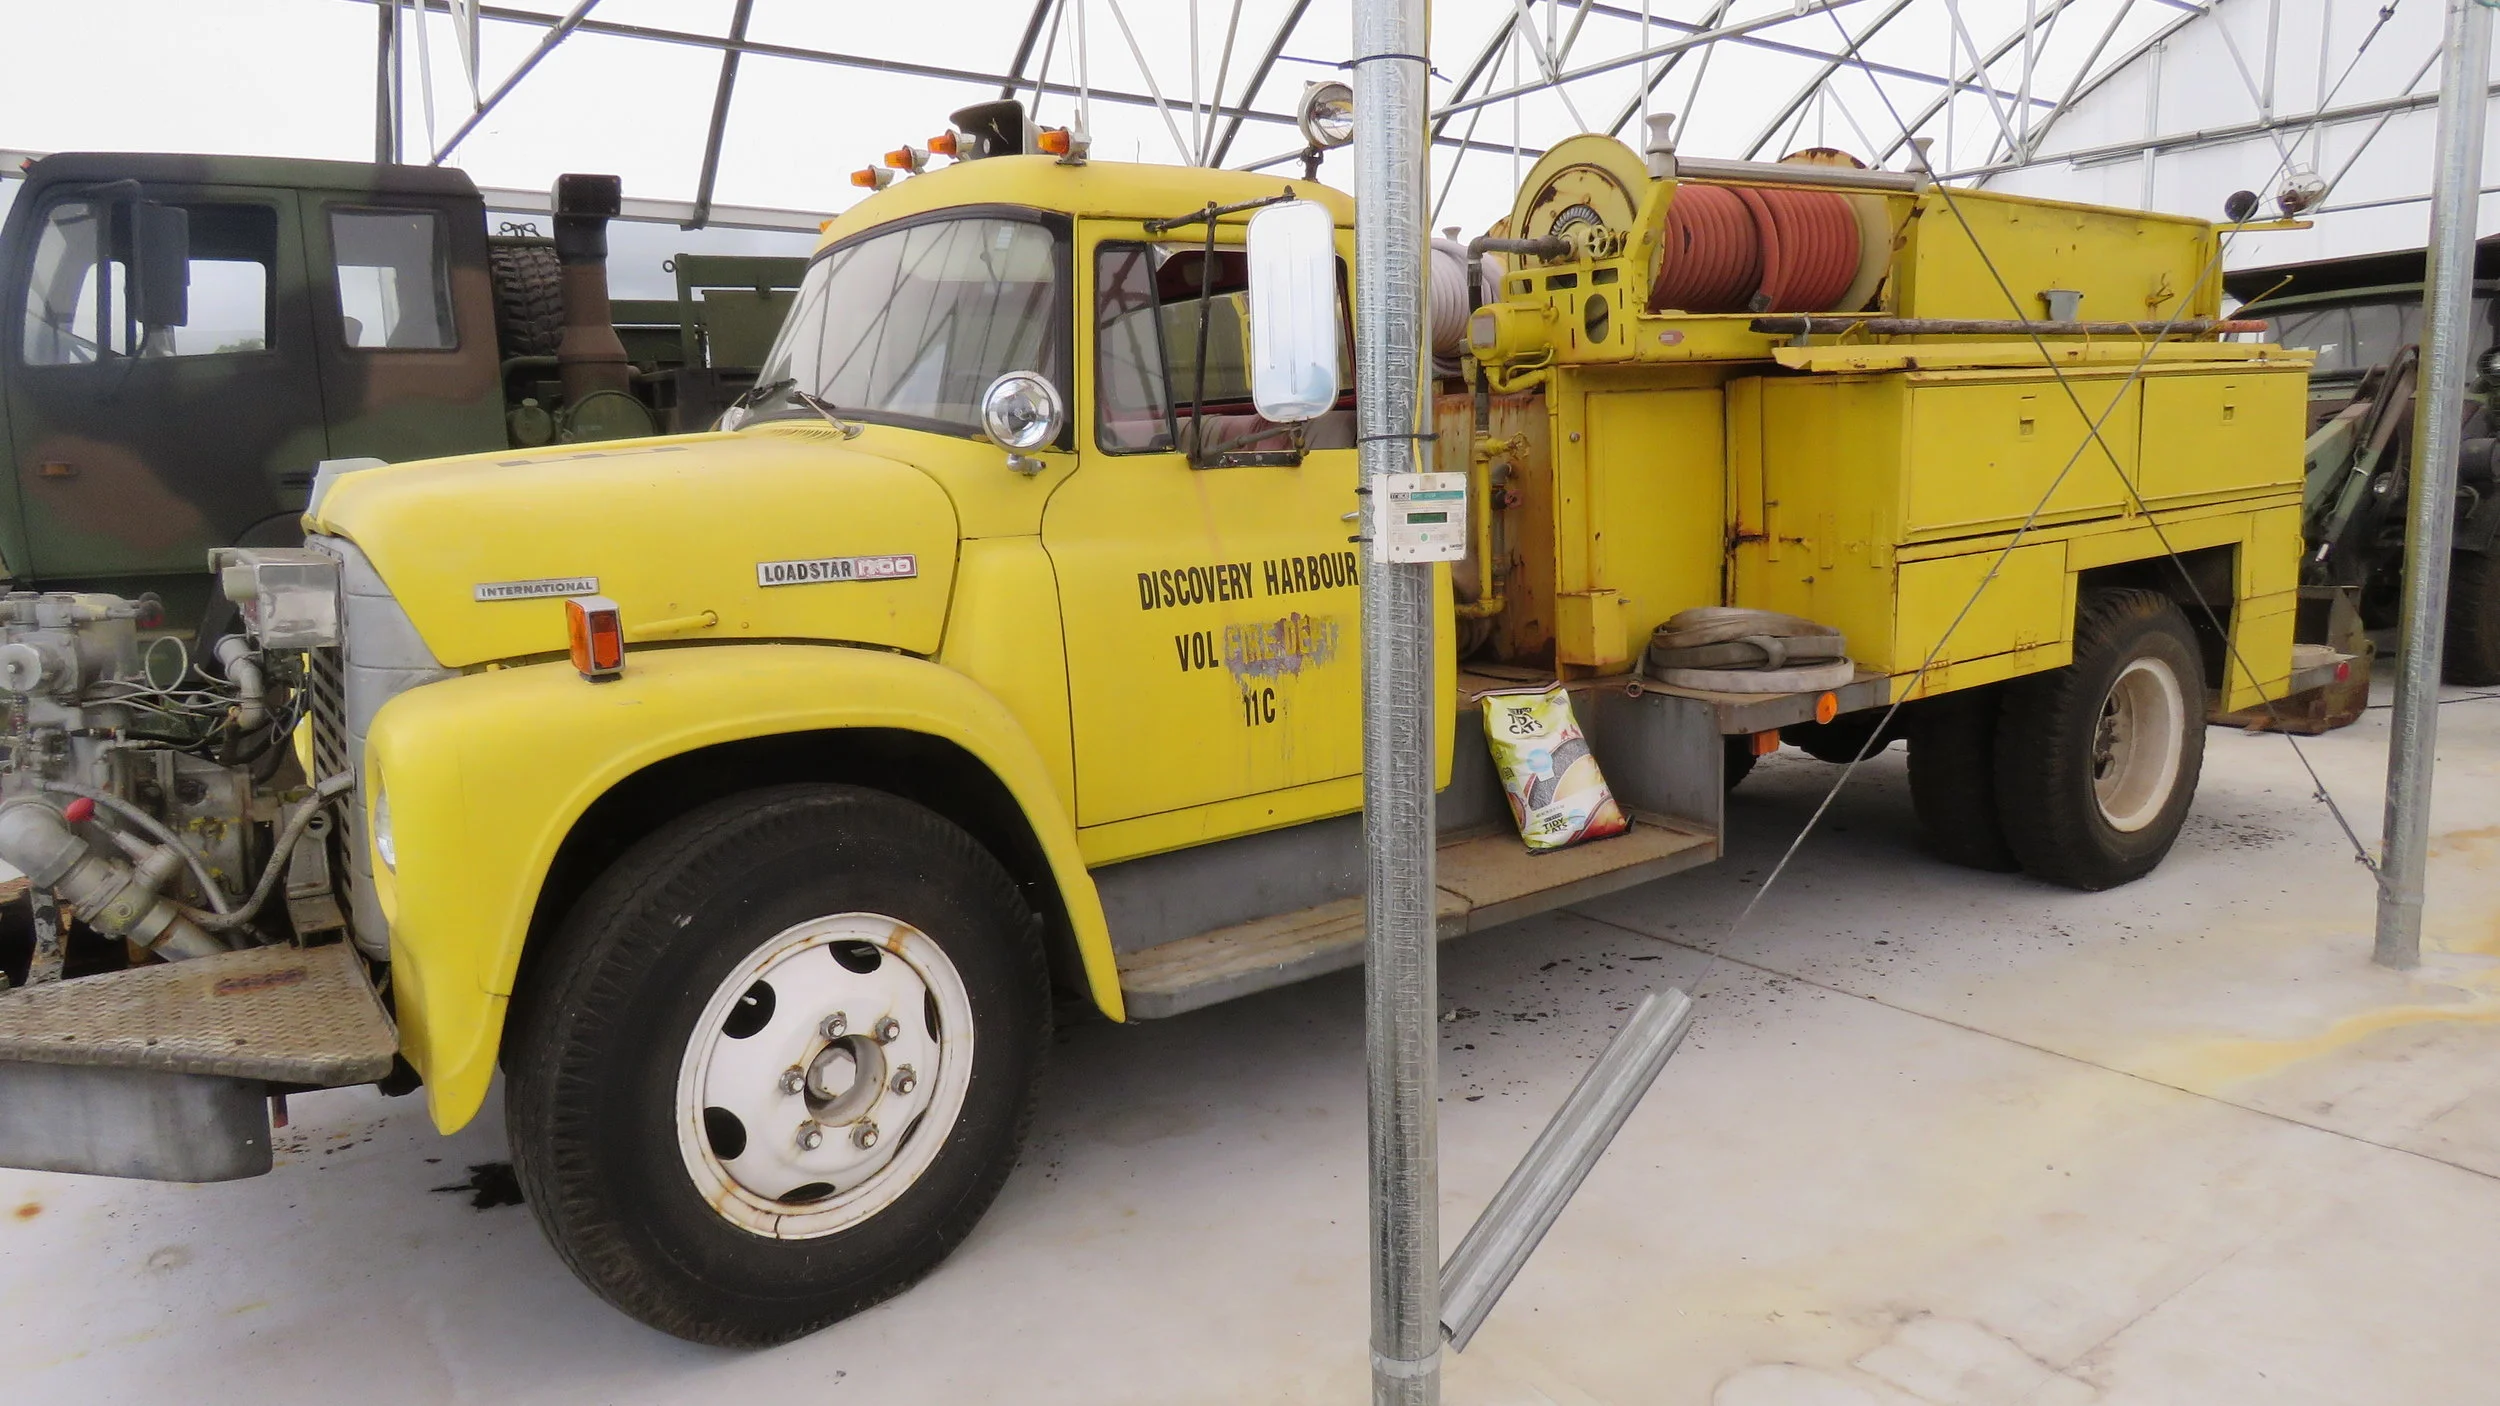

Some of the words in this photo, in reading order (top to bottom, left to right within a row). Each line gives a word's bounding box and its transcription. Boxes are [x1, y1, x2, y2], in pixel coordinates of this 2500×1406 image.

[764, 560, 852, 583] LOADSTAR
[481, 581, 593, 597] INTERNATIONAL
[1137, 562, 1253, 611] DISCOVERY
[1263, 551, 1360, 596] HARBOUR
[1175, 631, 1219, 672] VOL
[1508, 713, 1533, 725] TDY
[1509, 720, 1543, 734] CATS
[1543, 817, 1563, 830] TIDY
